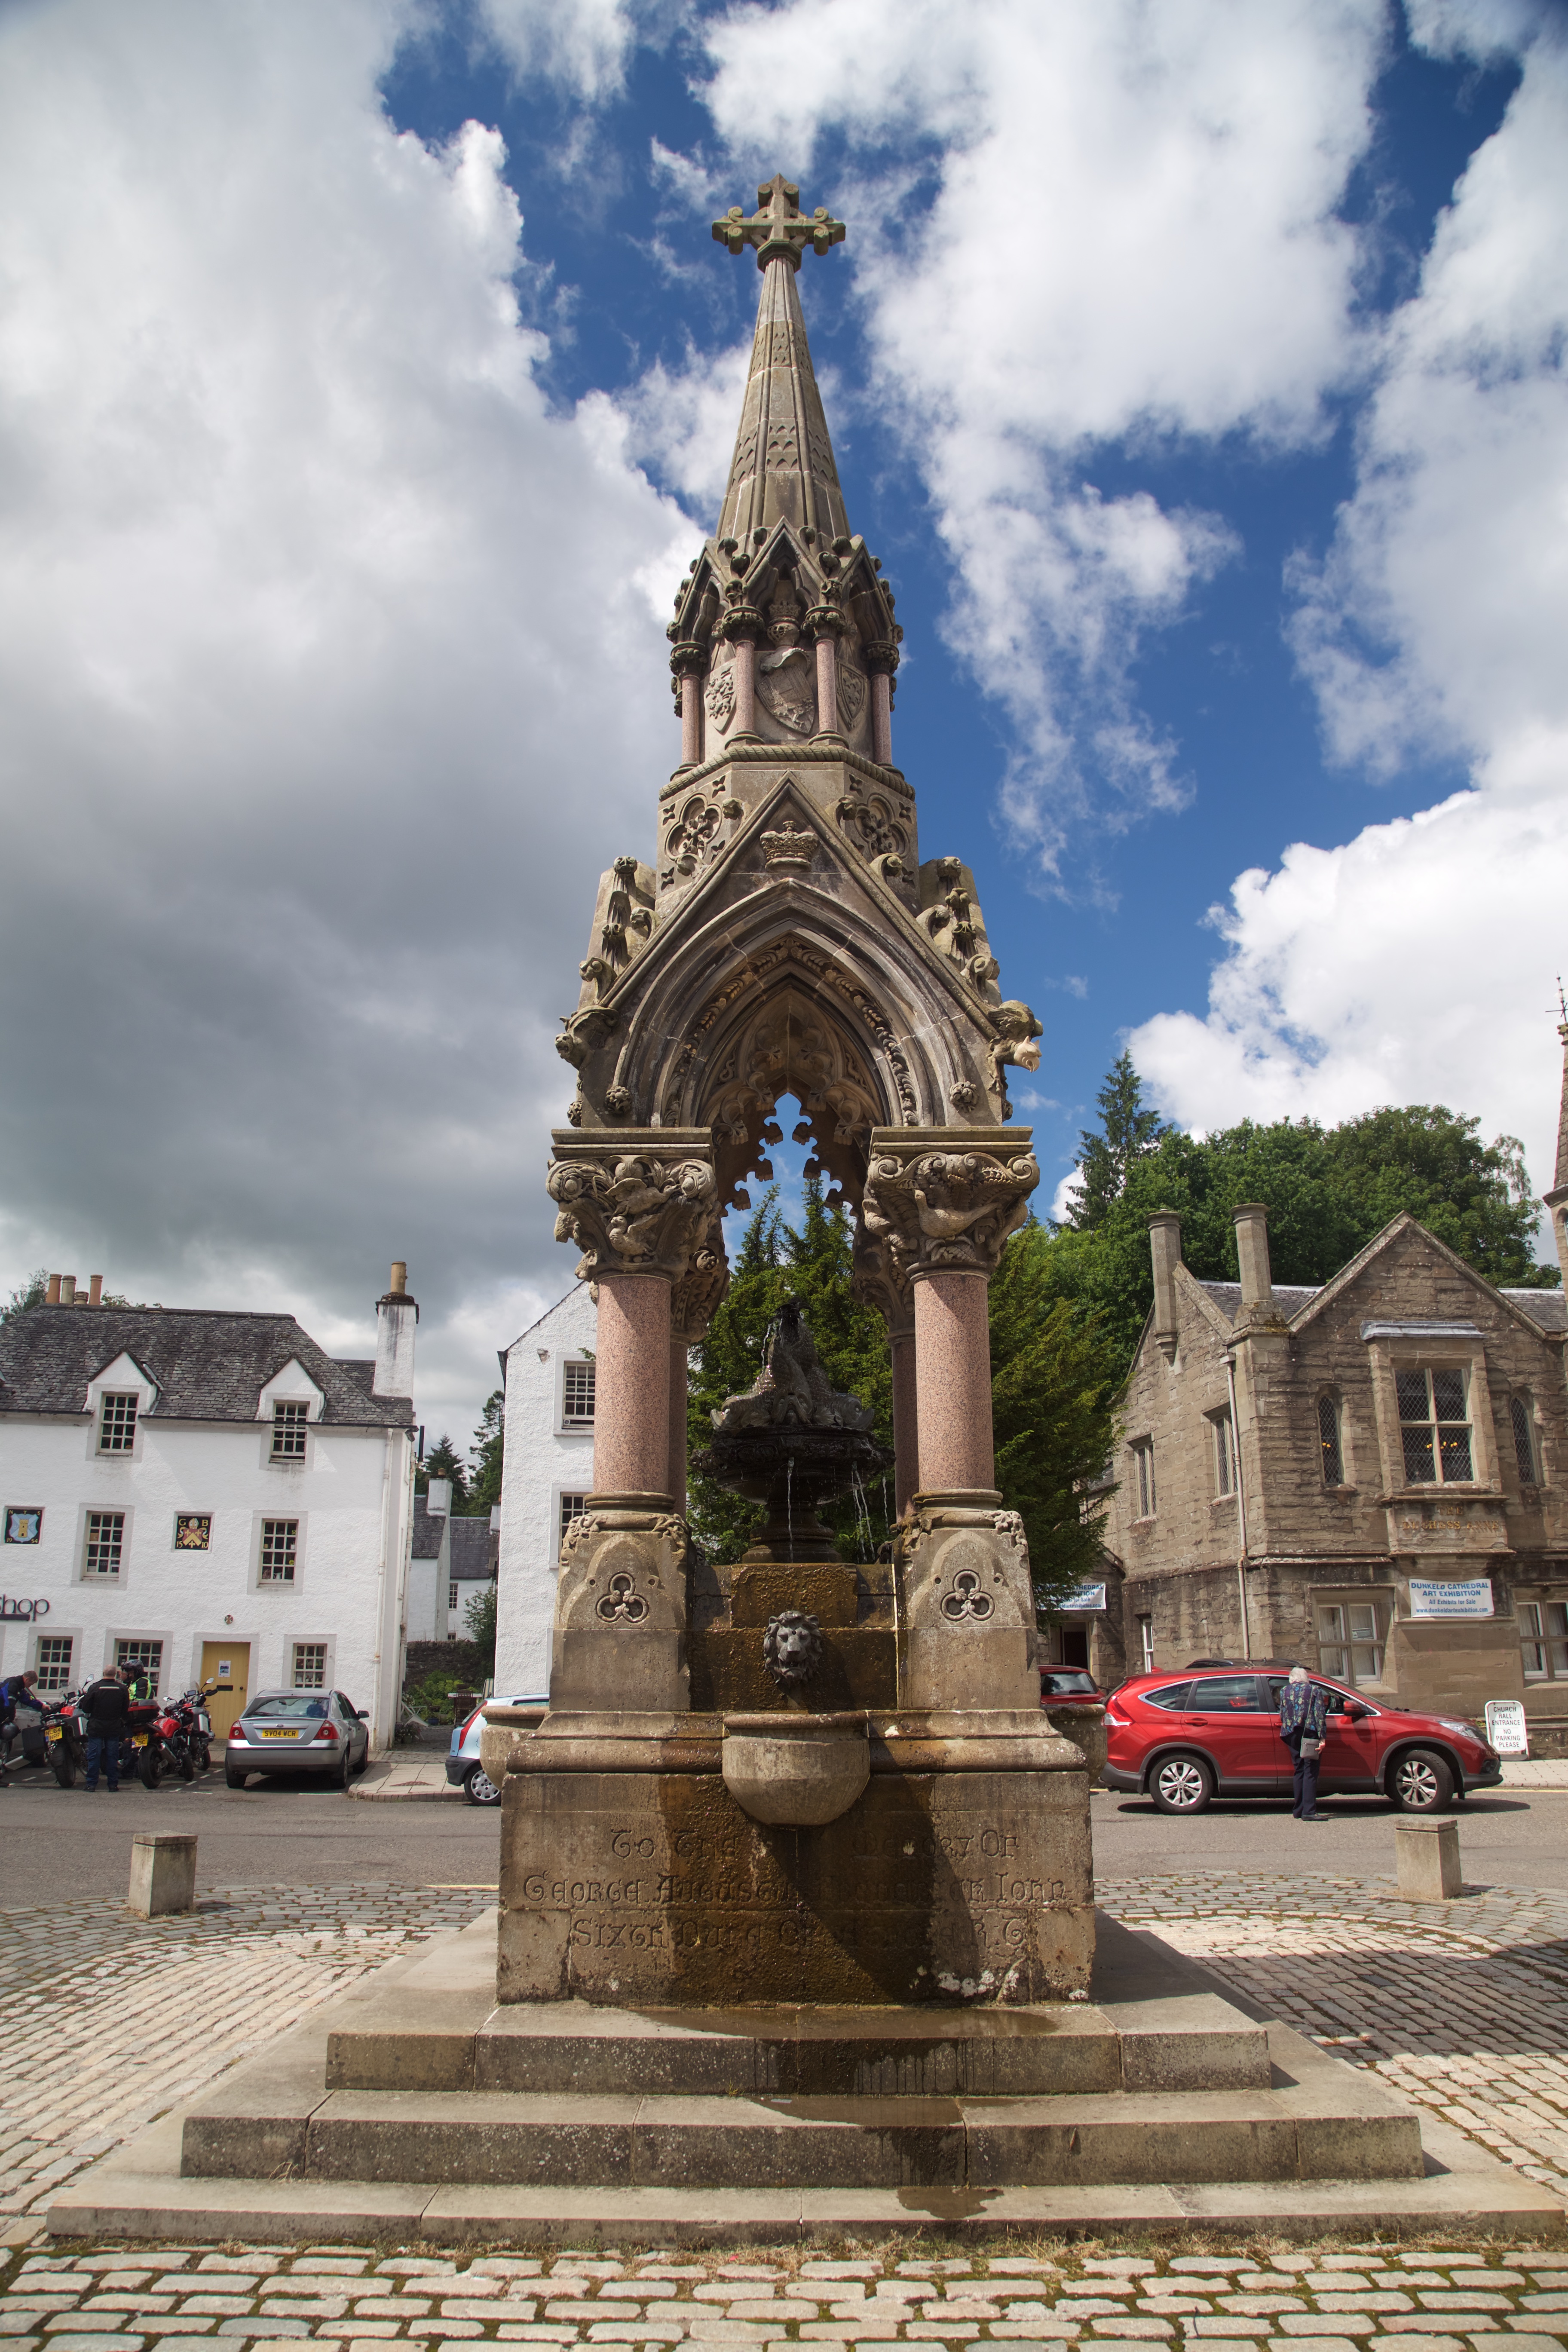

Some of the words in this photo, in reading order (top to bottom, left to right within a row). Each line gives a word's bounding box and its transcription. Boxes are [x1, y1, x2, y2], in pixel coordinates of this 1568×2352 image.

[1437, 1507, 1463, 1516] THE
[1403, 1520, 1461, 1529] DUCHESS
[0, 1593, 50, 1621] hop
